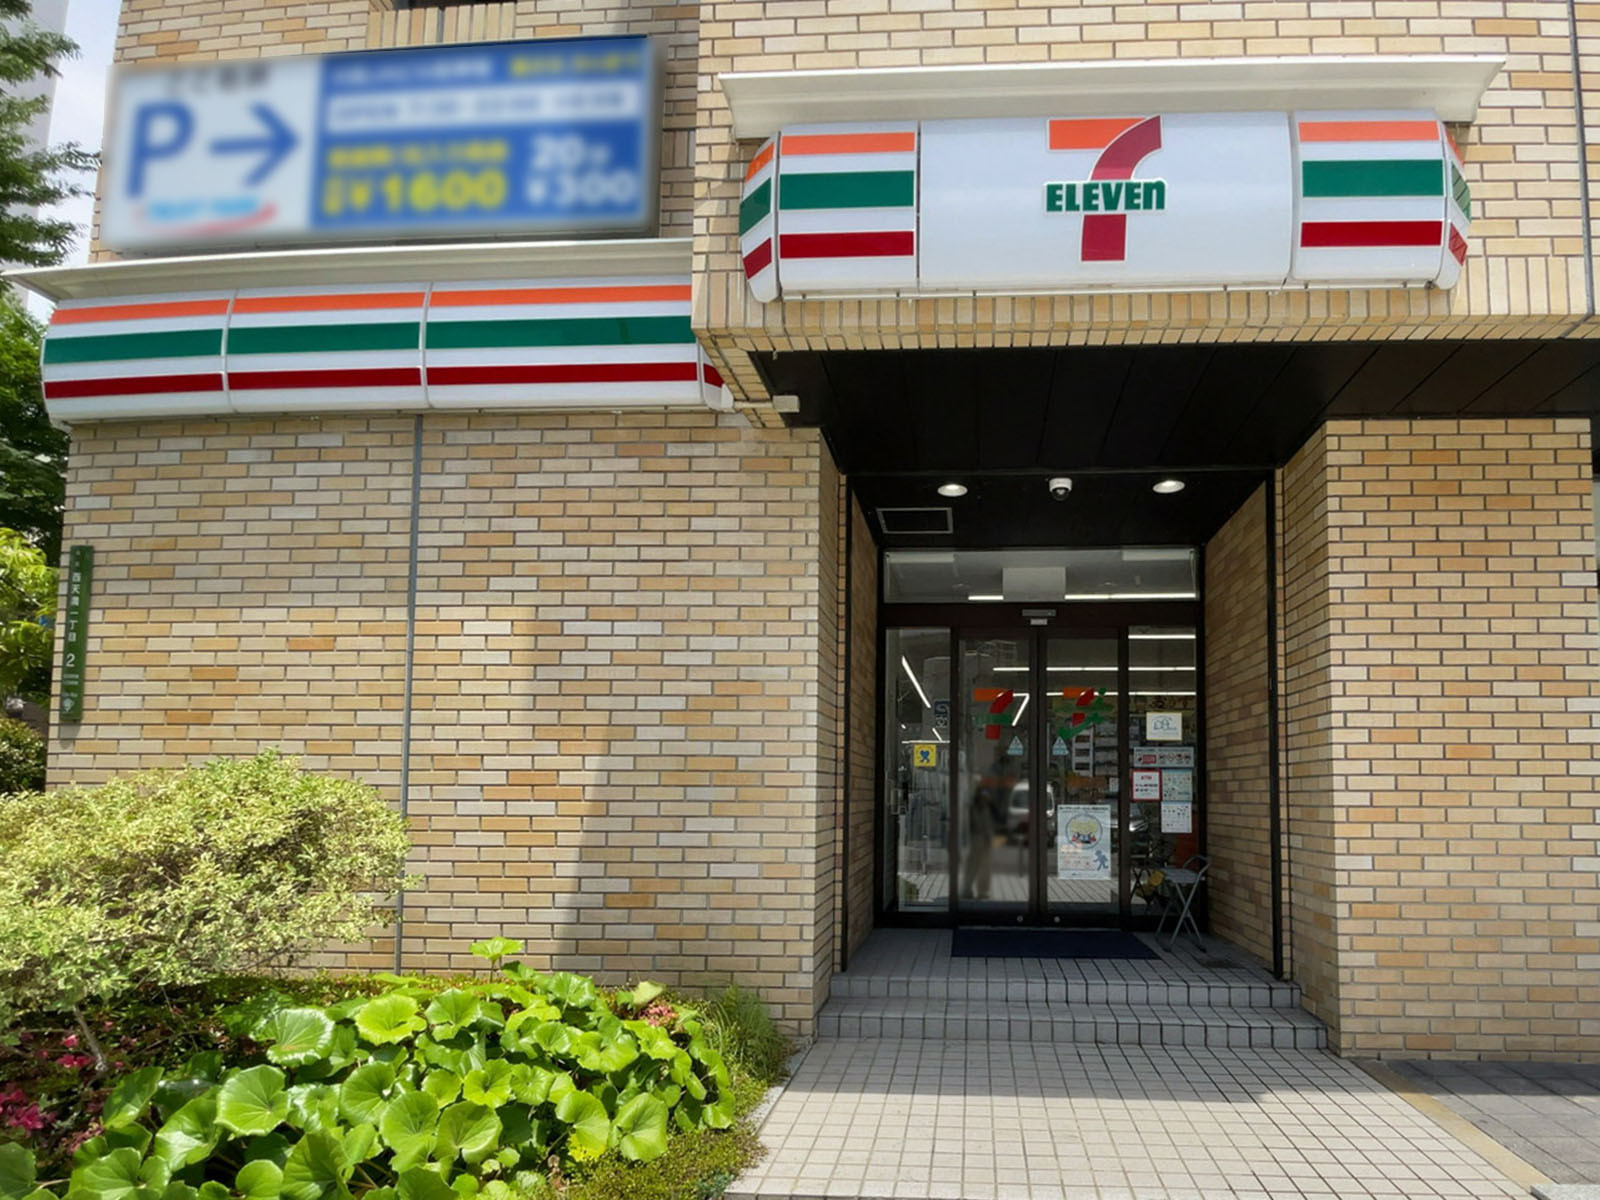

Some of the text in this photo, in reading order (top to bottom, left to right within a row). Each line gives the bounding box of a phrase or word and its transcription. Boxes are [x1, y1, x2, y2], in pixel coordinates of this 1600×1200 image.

[126, 101, 195, 199] P
[1049, 115, 1162, 261] 7
[66, 654, 75, 667] 2
